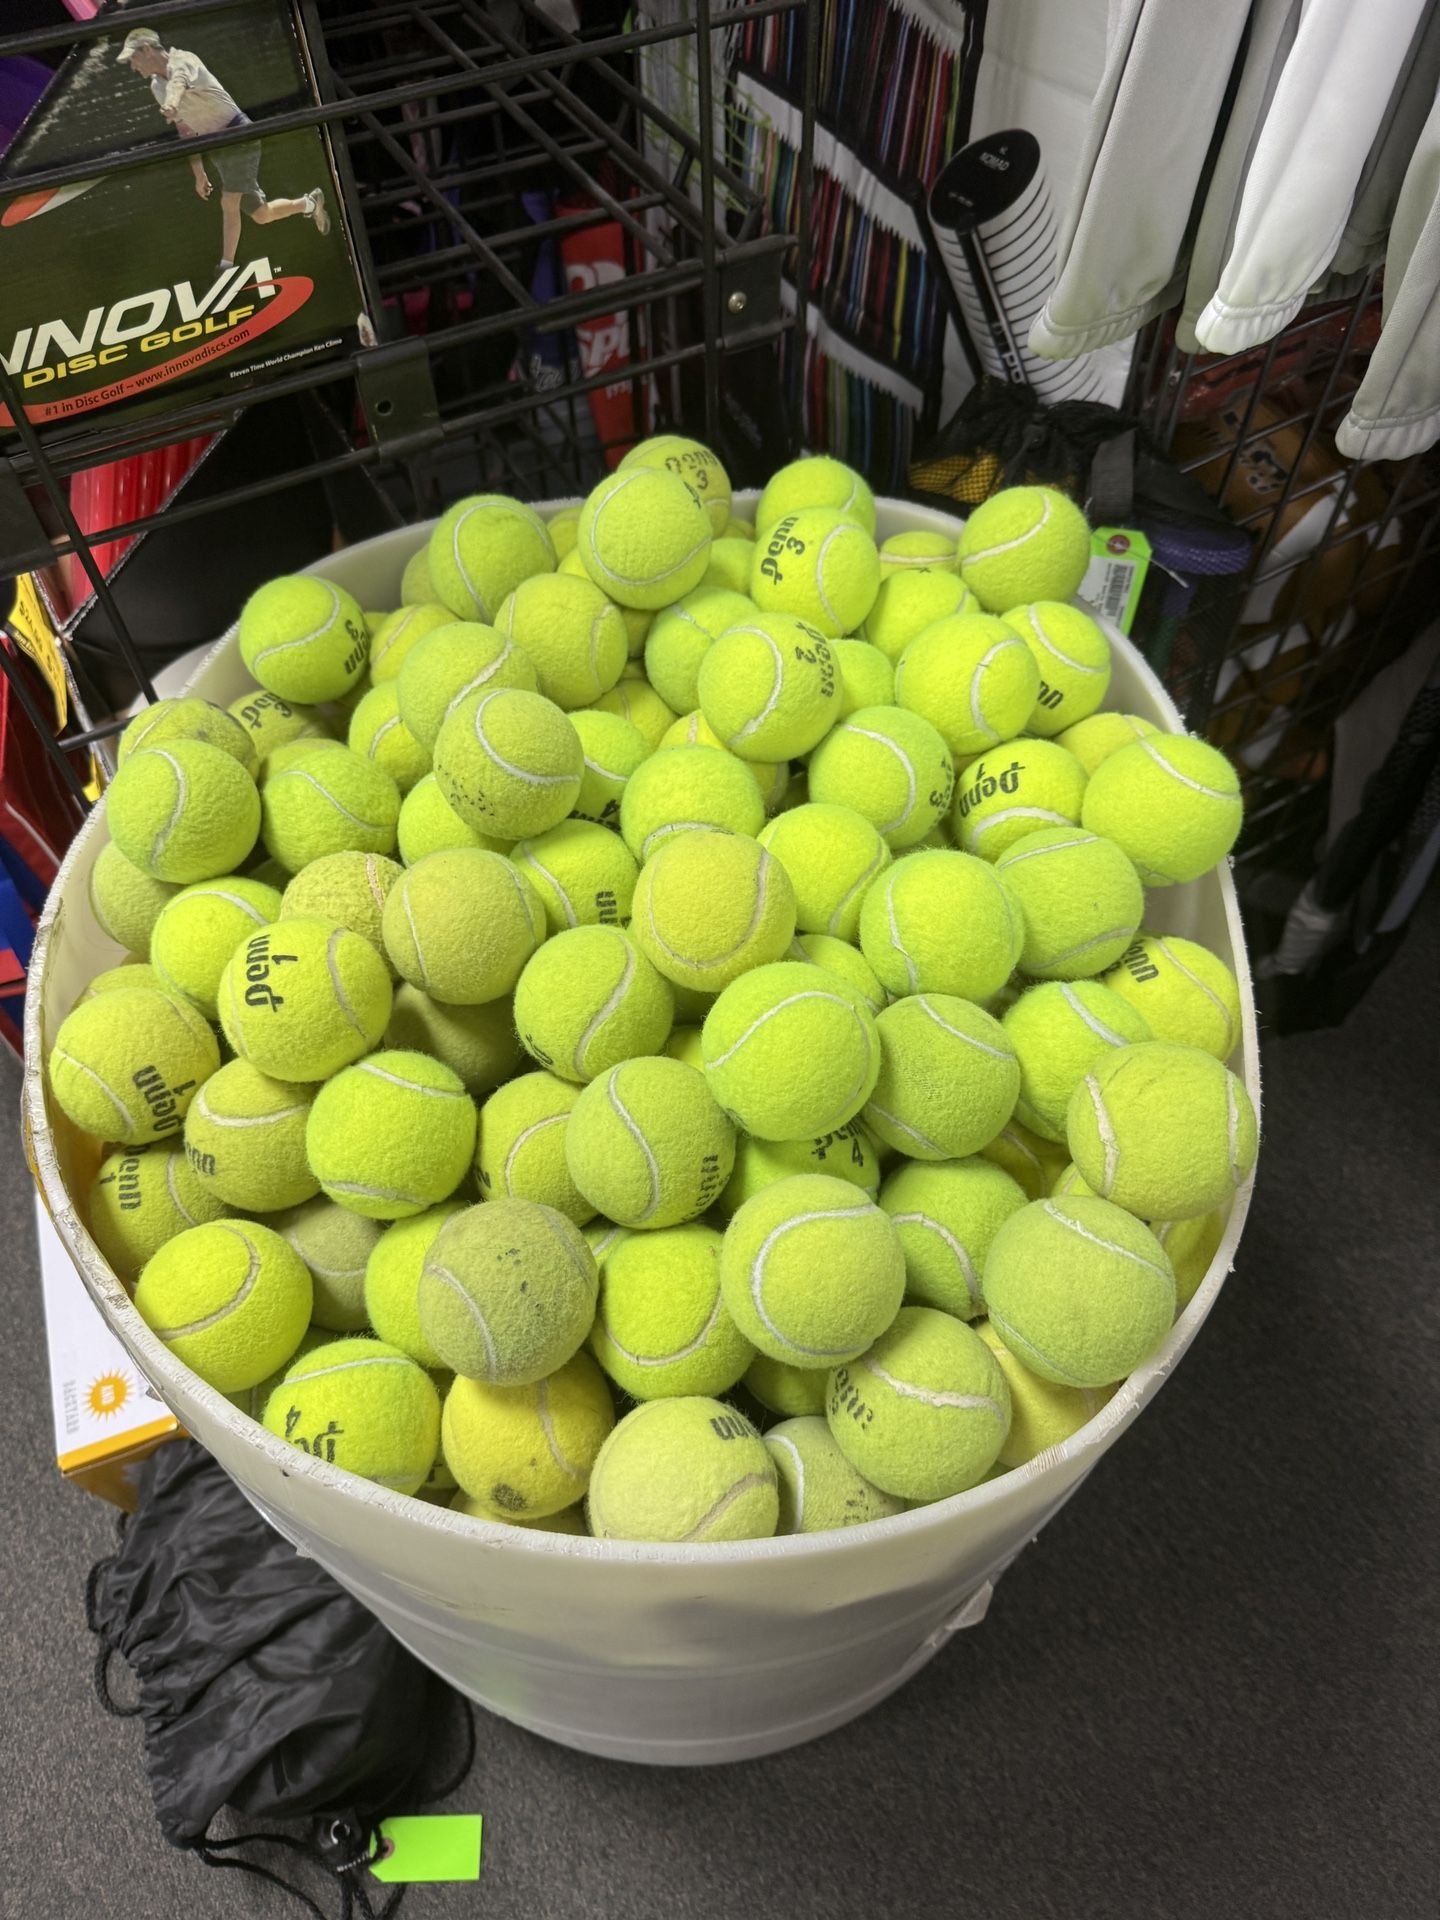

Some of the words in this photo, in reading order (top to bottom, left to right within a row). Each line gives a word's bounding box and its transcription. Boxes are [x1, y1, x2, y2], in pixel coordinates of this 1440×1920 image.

[23, 344, 129, 389] DISC
[140, 304, 255, 352] GOLF
[229, 367, 250, 379] Eleven
[250, 362, 265, 373] Time
[265, 356, 283, 367] World
[283, 347, 314, 361] Champion
[314, 343, 325, 352] Ken
[45, 404, 60, 416] #1
[62, 401, 73, 413] in
[75, 394, 99, 408] Disc
[101, 383, 125, 400] Golf
[136, 328, 251, 388] www.innovadiscs.com
[696, 468, 709, 491] 3
[760, 516, 800, 586] Penn
[786, 536, 806, 556] 3
[345, 618, 360, 642] 3
[795, 645, 817, 665] 2
[959, 761, 1027, 818] Penn
[244, 933, 285, 1013] Penn
[271, 953, 299, 966] 1
[172, 1079, 197, 1097] 1
